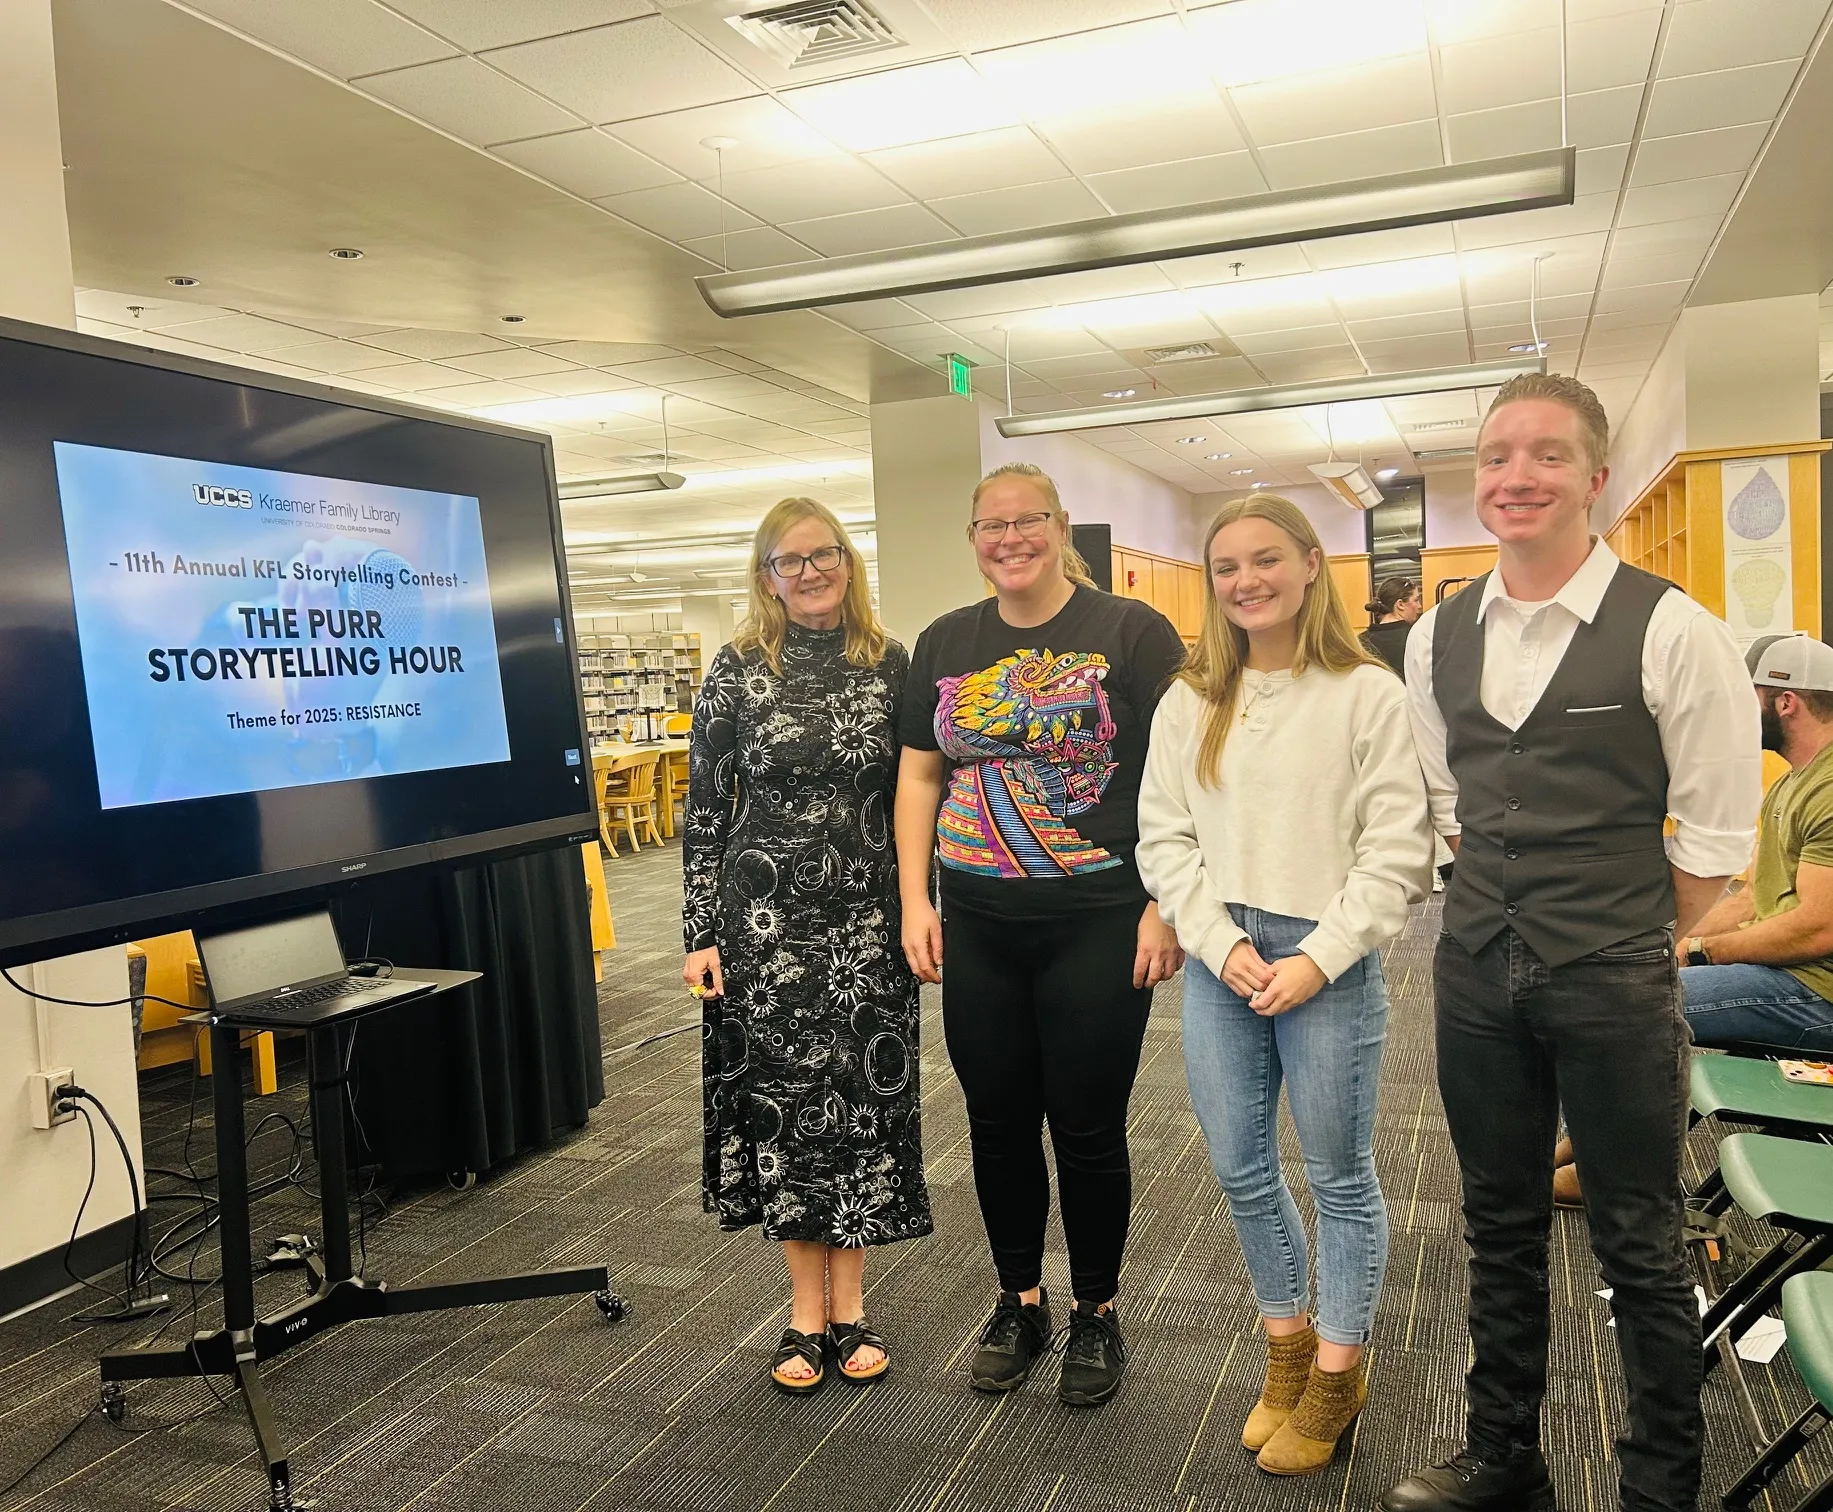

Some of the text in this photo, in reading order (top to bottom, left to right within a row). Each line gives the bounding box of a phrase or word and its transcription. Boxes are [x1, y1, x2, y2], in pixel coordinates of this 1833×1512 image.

[192, 484, 253, 509] UCCS
[259, 493, 400, 526] Kraemer Family Library
[261, 517, 391, 535] UNIVERSITY OF COLORADO COLORADO SPRINGS
[124, 551, 165, 573] 11th
[173, 554, 247, 578] Annual
[252, 559, 287, 580] KFL
[292, 562, 394, 589] Storytelling
[399, 568, 458, 588] Contest
[238, 607, 385, 639] THE PURR
[148, 646, 465, 682] STORYTELLING HOUR
[227, 702, 422, 729] Theme for 2025: RESISTANCE
[341, 862, 367, 873] SHARP
